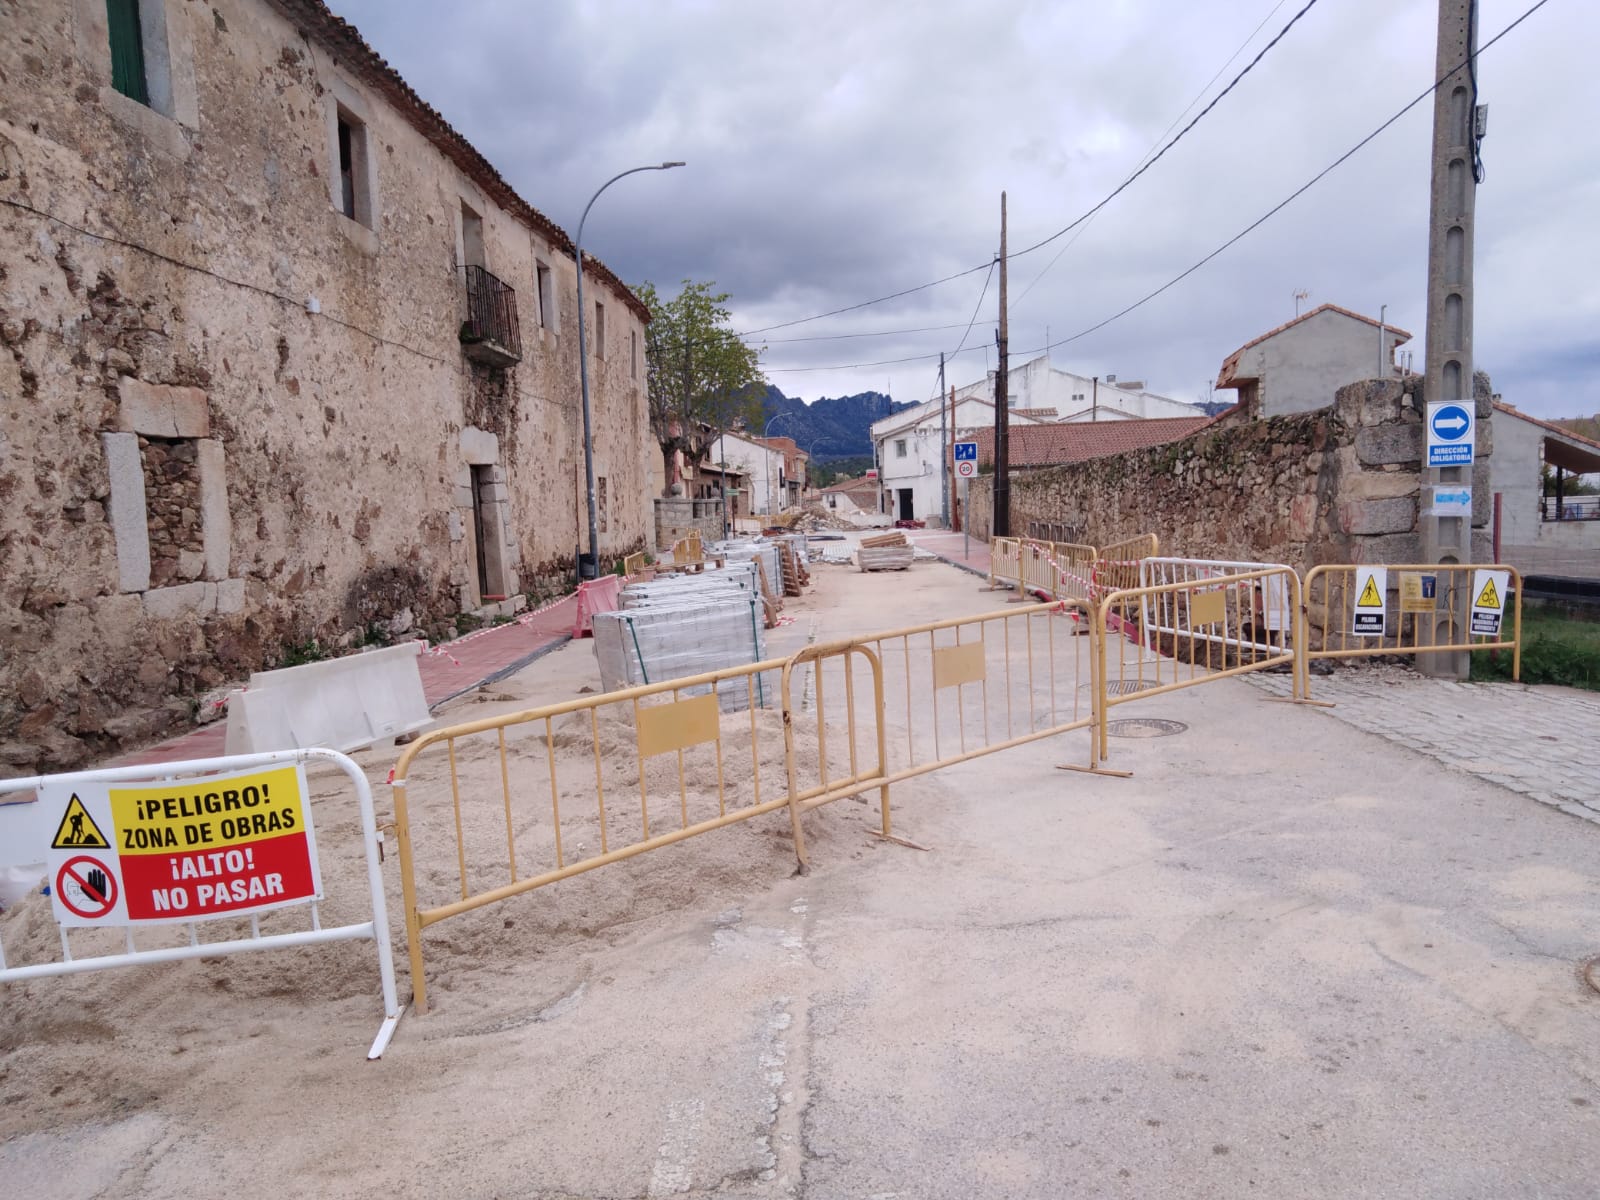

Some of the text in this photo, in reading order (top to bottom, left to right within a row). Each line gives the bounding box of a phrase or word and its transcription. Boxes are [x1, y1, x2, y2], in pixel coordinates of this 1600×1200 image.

[1431, 454, 1471, 462] OBLIGATORIA
[1434, 446, 1468, 455] DIRECCIÓN
[137, 784, 271, 820] ¡PELIGRO!
[123, 808, 296, 849] ZONA DE OBRAS
[170, 848, 255, 880] ¡ALTO!
[152, 873, 285, 912] NO PASAR
